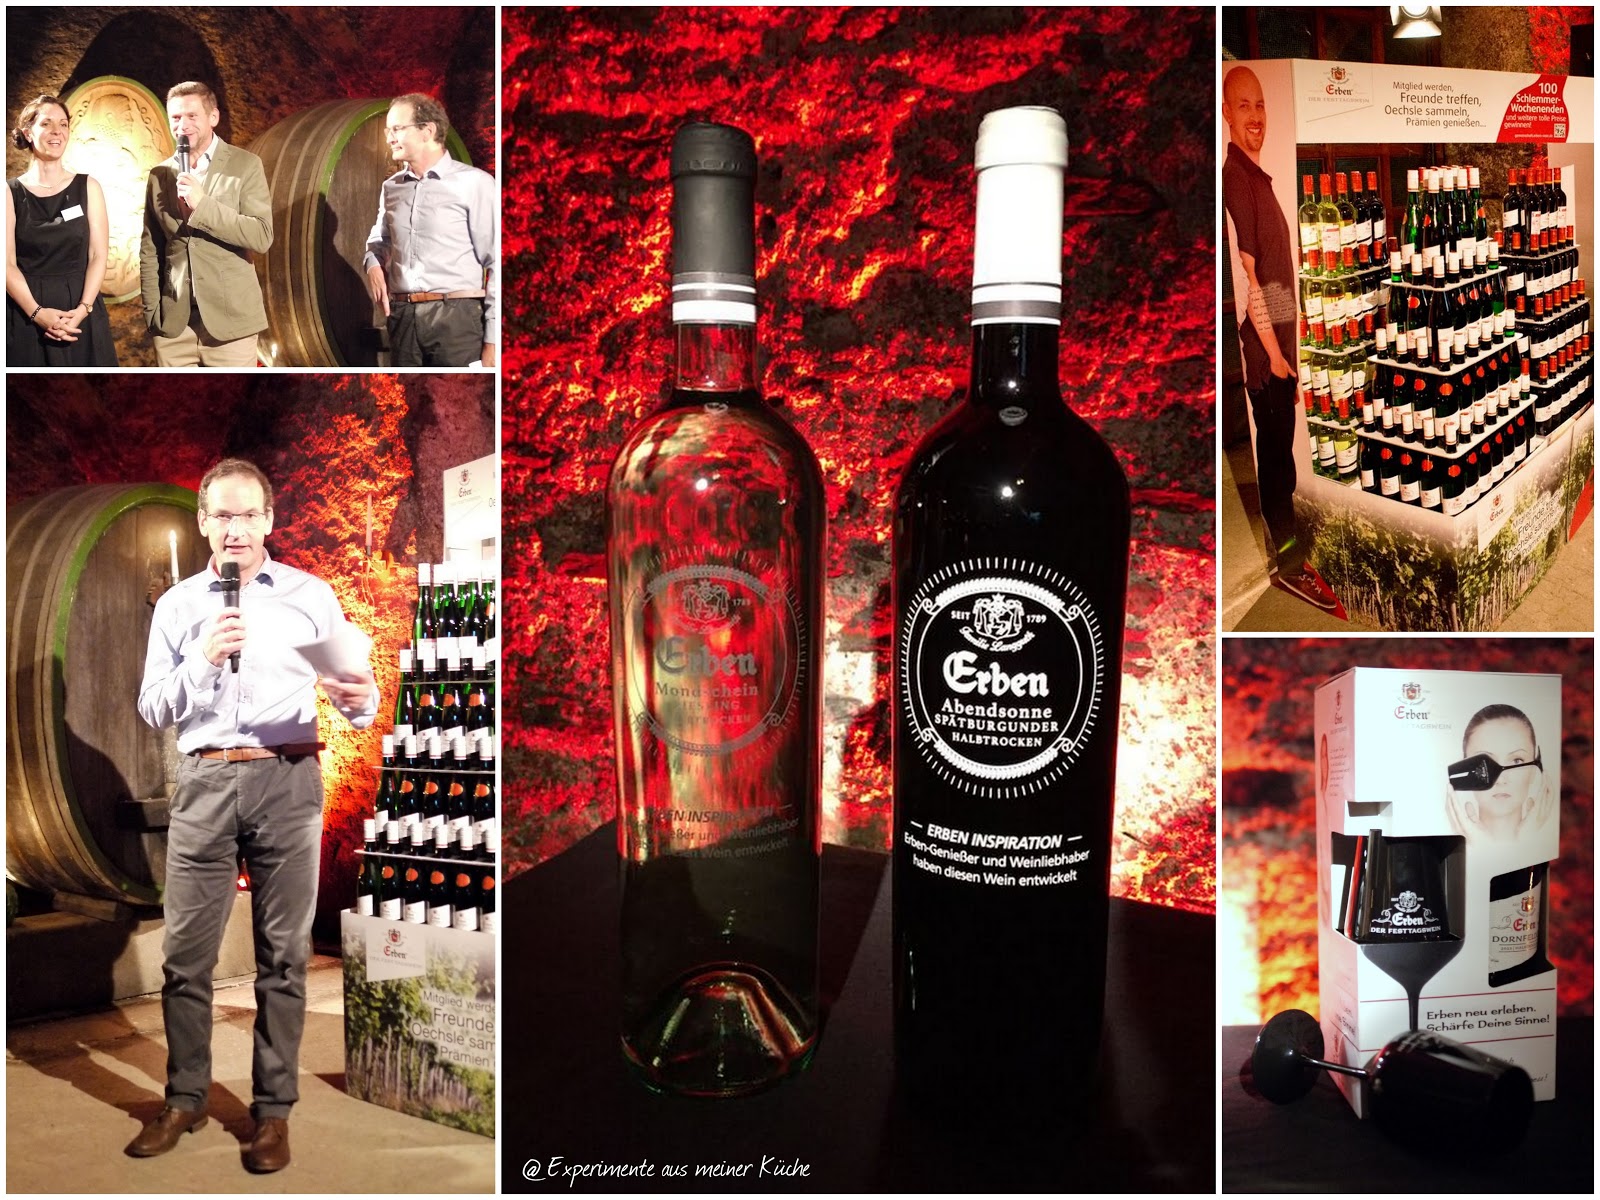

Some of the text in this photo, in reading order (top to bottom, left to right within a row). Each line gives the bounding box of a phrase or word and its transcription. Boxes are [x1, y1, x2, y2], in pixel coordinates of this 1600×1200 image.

[1326, 84, 1353, 96] Erben
[1393, 82, 1454, 93] Mitglied werden,
[1538, 82, 1558, 94] 100
[1400, 92, 1482, 107] Freunde treffen,
[1516, 93, 1561, 104] Schlemmer-
[1384, 105, 1470, 118] Oechsle sammeln,
[1510, 103, 1564, 114] Wochenenden
[1406, 118, 1441, 127] Prämien
[1503, 121, 1532, 130] gewinnen!
[951, 610, 971, 621] SEIT
[1026, 614, 1047, 624] 1789
[656, 636, 758, 677] Erben
[942, 650, 1050, 698] Erben
[941, 697, 1053, 719] Abendsonne
[1394, 705, 1430, 720] Erben
[934, 711, 1059, 733] SPÄTBURGUNDER
[952, 731, 1043, 748] HALBTROCKEN
[687, 805, 774, 823] INSPIRION
[926, 823, 1063, 850] ERBEN INSPIRATION
[904, 832, 1091, 868] Erben-Genießer und Weinliebhaber
[912, 854, 1078, 887] haben diesen Wein entwickelt
[1391, 912, 1424, 926] Erben
[1513, 918, 1536, 932] Ern
[1370, 925, 1442, 935] DER FESTTAGSWEIN
[384, 945, 407, 959] Erben
[423, 990, 463, 1009] Mitglied
[1426, 1004, 1537, 1020] Erben neu erleben.
[433, 1007, 495, 1033] Freunde
[1426, 1014, 1550, 1032] Schärfe Deine Sinne!
[411, 1022, 465, 1046] Oechsle
[440, 1045, 490, 1067] Prämien
